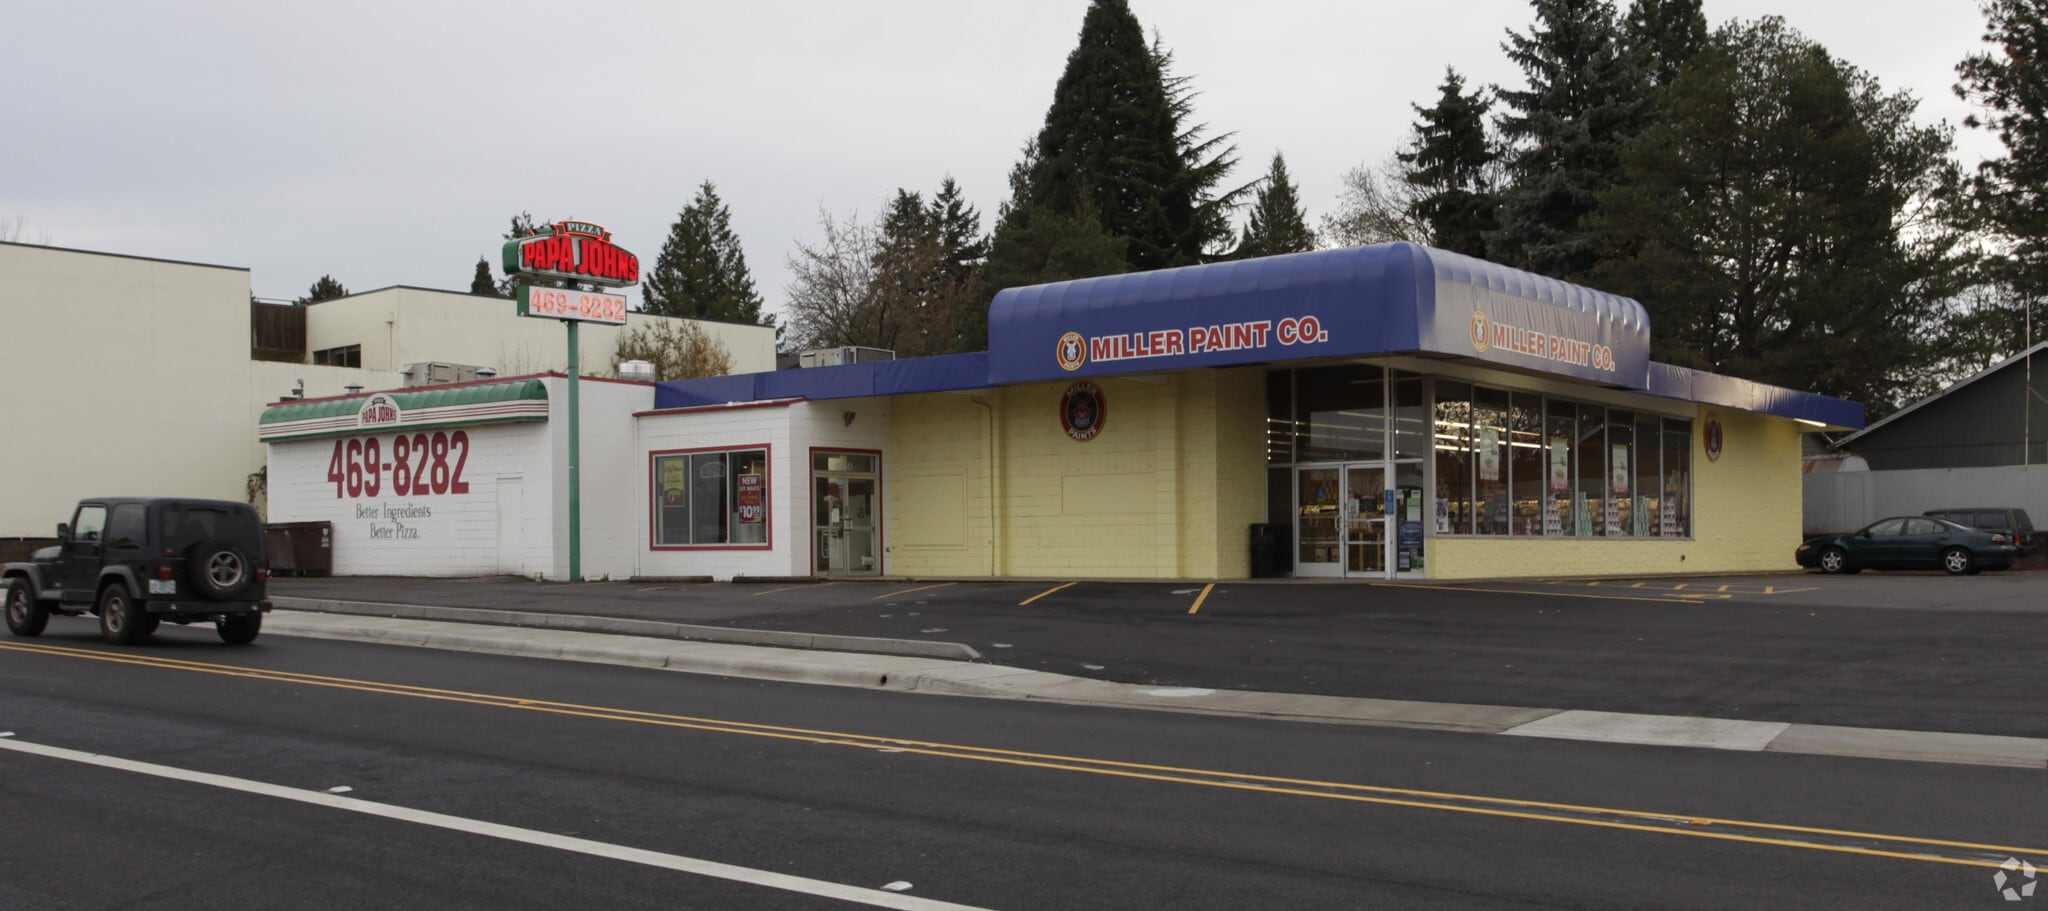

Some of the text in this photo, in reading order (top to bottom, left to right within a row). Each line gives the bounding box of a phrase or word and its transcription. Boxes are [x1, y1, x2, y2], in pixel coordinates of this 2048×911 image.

[567, 222, 601, 236] PIZZA
[524, 237, 576, 272] PAPA
[531, 289, 624, 321] 469-8282
[1090, 315, 1328, 363] MILLER PAINT CO.
[1492, 322, 1616, 372] MILLER PAINT CO.
[1066, 383, 1098, 397] MILLER
[362, 407, 377, 423] PAPA
[1067, 426, 1097, 440] PAINTS
[327, 430, 470, 499] 469-8282
[741, 477, 757, 486] NEW
[355, 502, 432, 523] Better Ingredients
[370, 522, 421, 540] Better Pizza.
